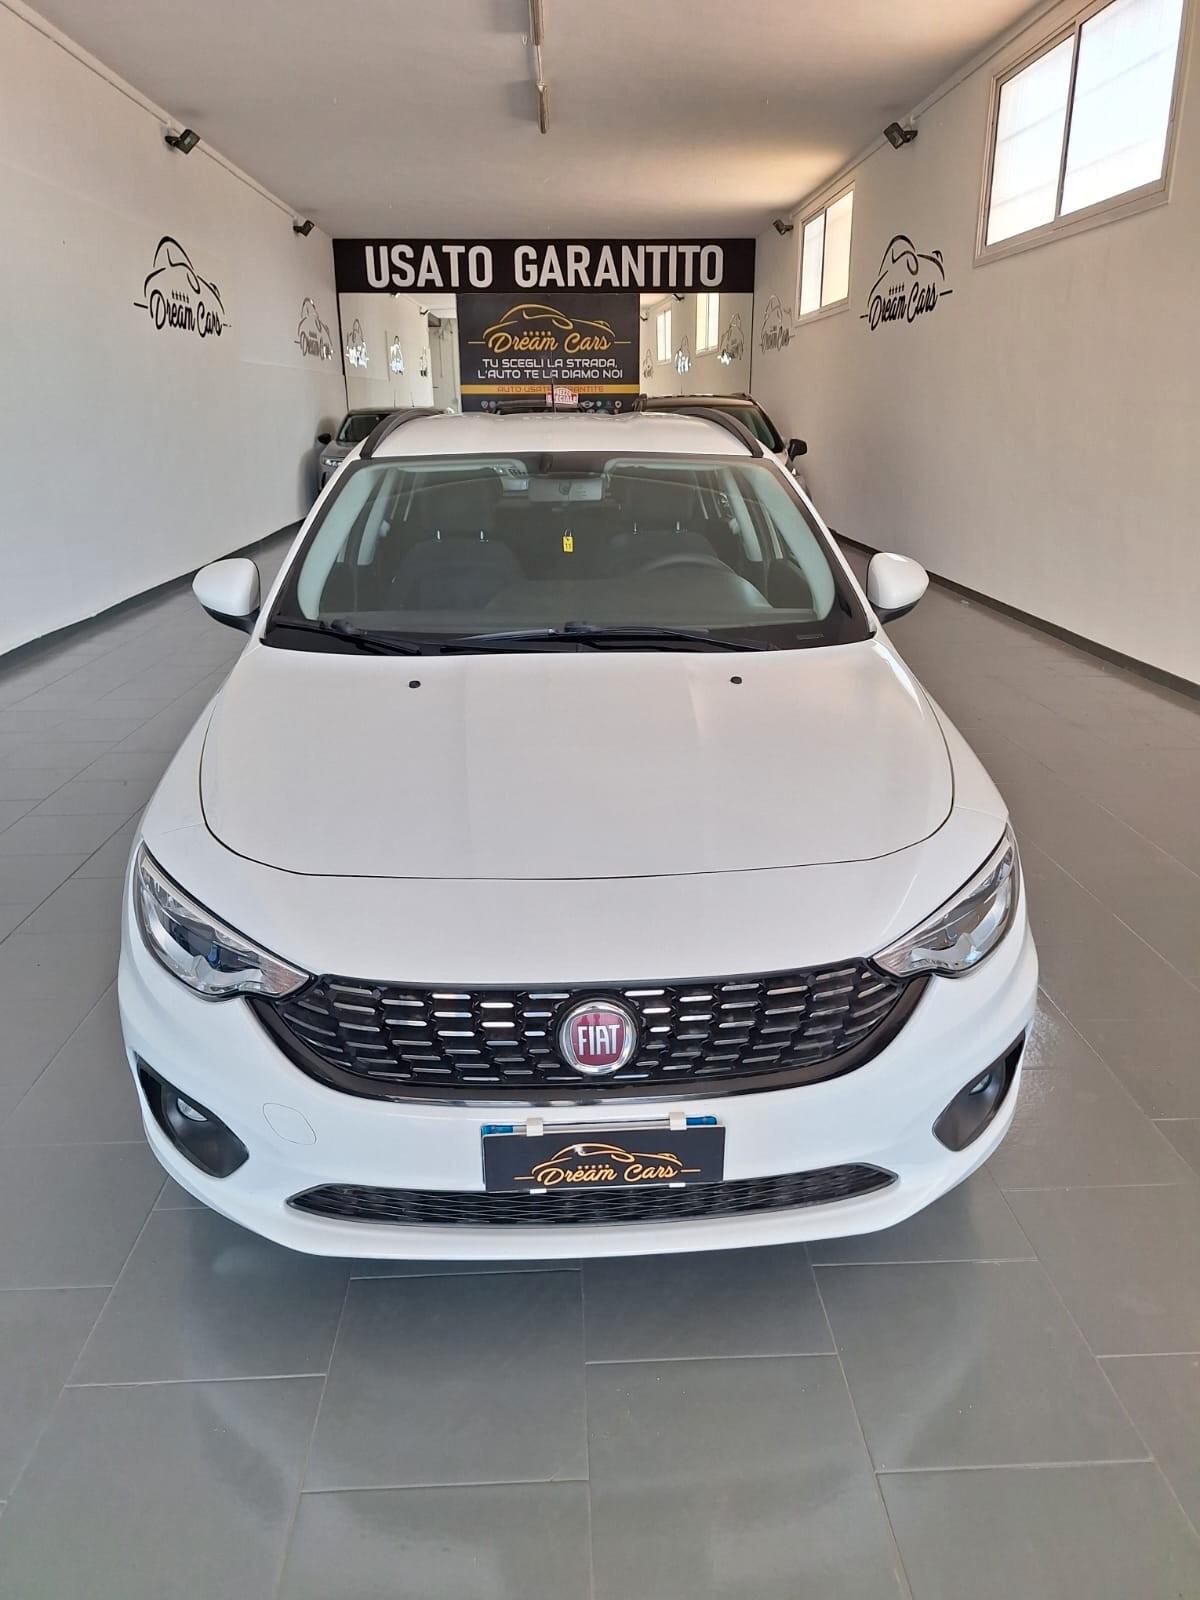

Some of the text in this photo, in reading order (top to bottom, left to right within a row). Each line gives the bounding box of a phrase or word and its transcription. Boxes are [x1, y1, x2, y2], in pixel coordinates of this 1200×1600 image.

[365, 245, 724, 288] USATO GARANTITO
[149, 289, 223, 338] Dream Cars
[868, 281, 940, 331] Dream Cars
[488, 332, 612, 353] Dream Cars
[477, 369, 623, 379] L'AUTO TE LA DIAMO NOI
[482, 358, 617, 369] TU SCEGLI LA STRADA,
[577, 1024, 620, 1056] FIAT
[537, 1163, 678, 1186] Dream Cars
